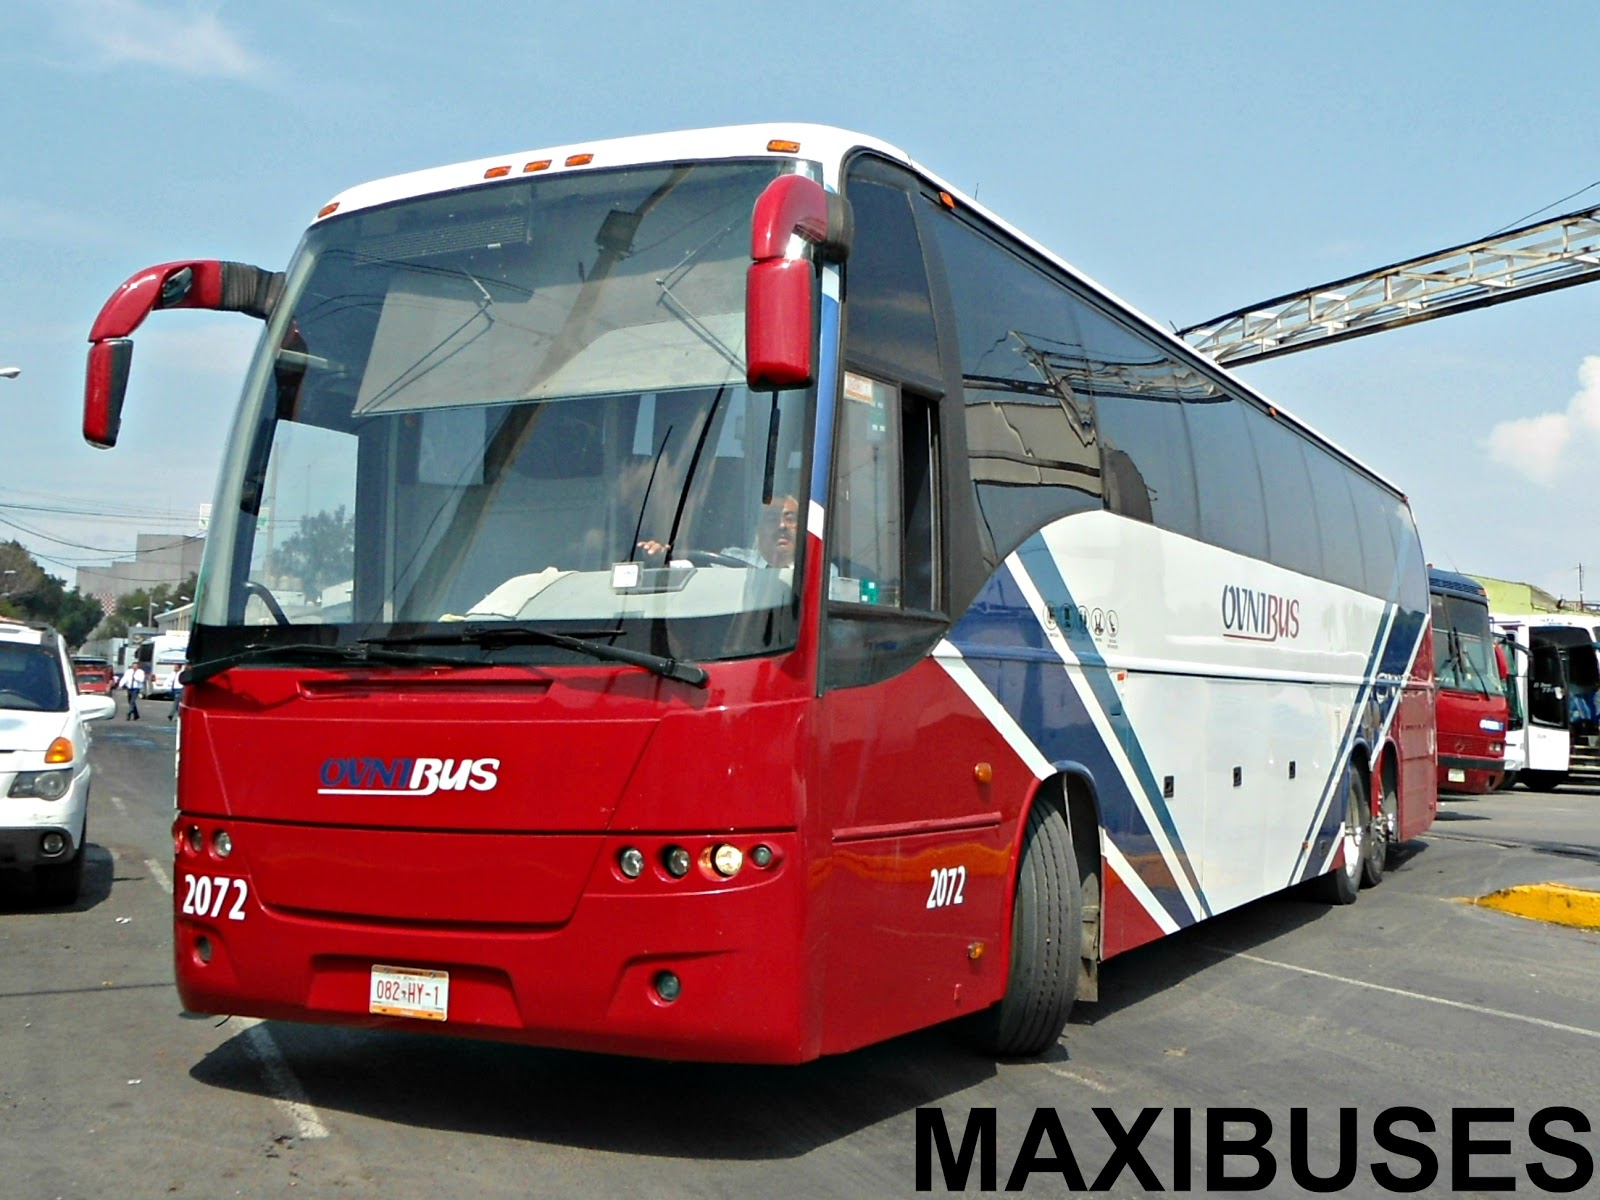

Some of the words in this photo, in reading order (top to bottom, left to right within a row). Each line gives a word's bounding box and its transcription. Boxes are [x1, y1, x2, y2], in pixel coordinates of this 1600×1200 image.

[1221, 584, 1300, 641] OVNIBUS
[318, 758, 500, 796] OVNIBUS
[183, 874, 248, 920] 2072
[926, 865, 966, 909] 2072
[376, 979, 439, 1006] 082-HY-1
